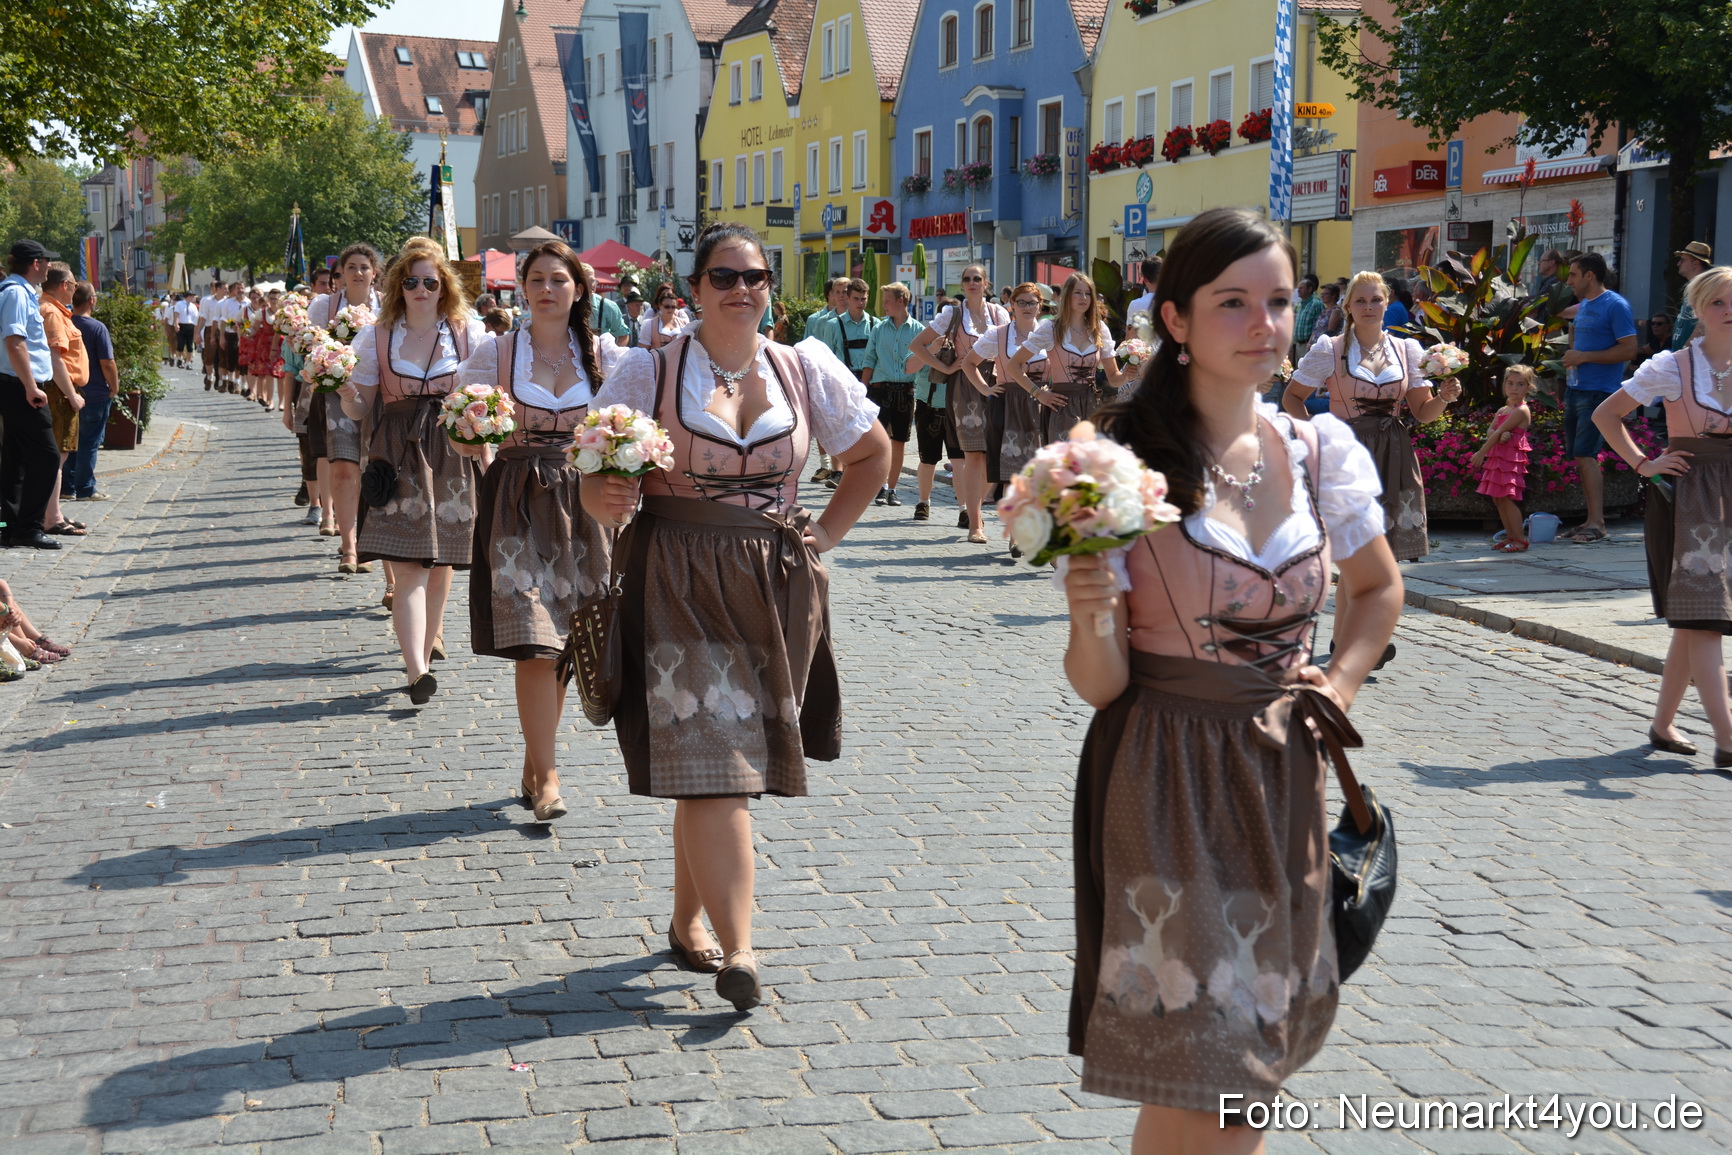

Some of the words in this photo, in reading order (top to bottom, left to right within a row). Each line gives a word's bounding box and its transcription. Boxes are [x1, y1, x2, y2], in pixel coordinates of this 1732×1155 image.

[1297, 105, 1317, 116] KINO
[741, 126, 763, 148] HOTEL
[768, 122, 793, 141] Lehmeier
[1450, 146, 1460, 181] P
[1415, 168, 1438, 180] DER
[1313, 180, 1328, 193] KINO
[1340, 154, 1349, 215] KINO
[1374, 177, 1388, 192] DER
[908, 213, 965, 239] APOTHEKE
[1129, 208, 1142, 234] P
[926, 303, 933, 313] P
